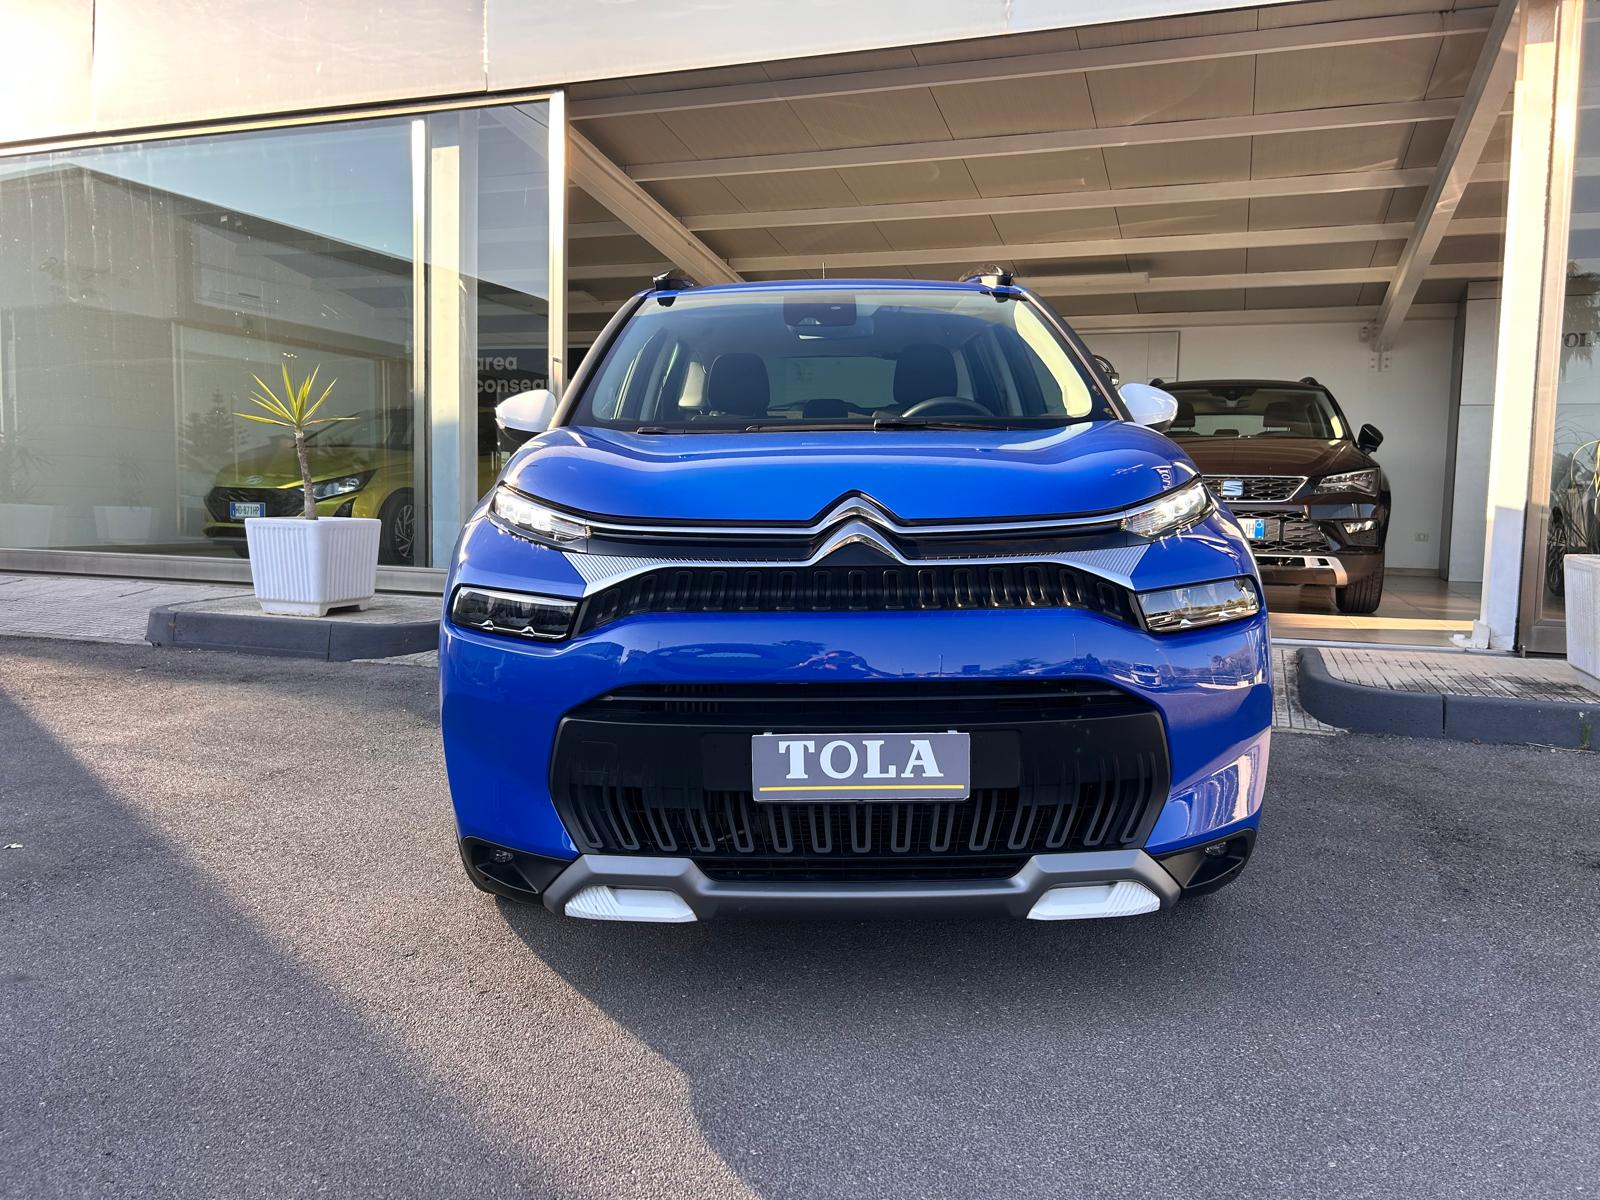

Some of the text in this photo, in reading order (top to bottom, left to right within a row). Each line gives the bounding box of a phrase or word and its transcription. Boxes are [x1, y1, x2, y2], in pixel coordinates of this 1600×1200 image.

[1562, 332, 1600, 348] OL
[478, 379, 549, 393] conseg
[778, 739, 944, 779] TOLA
